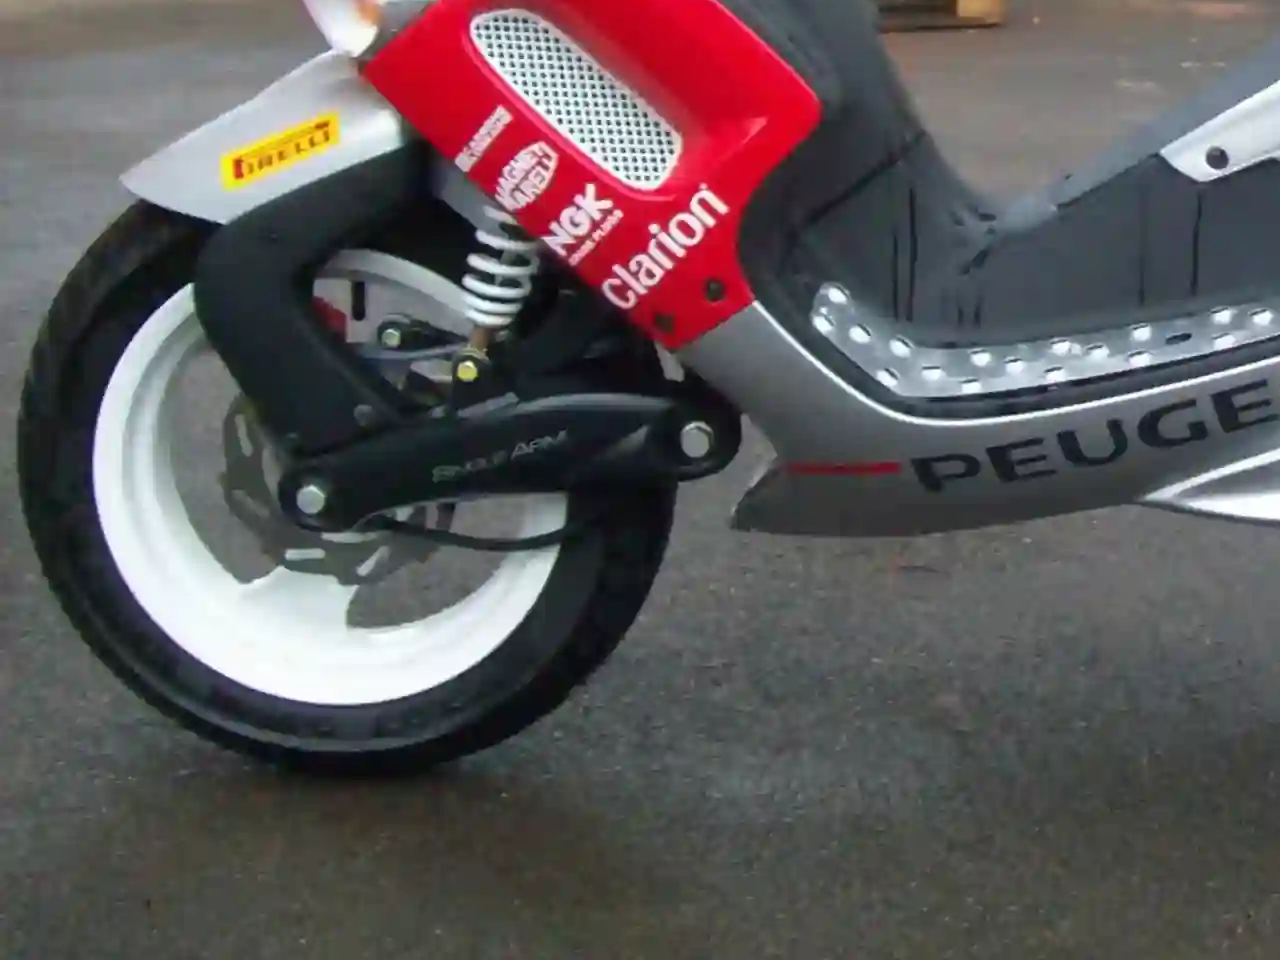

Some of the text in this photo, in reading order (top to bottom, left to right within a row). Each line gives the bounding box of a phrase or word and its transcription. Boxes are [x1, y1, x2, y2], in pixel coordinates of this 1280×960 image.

[231, 120, 331, 179] PIRELLI
[543, 184, 613, 256] NGK
[602, 184, 730, 310] Clarion
